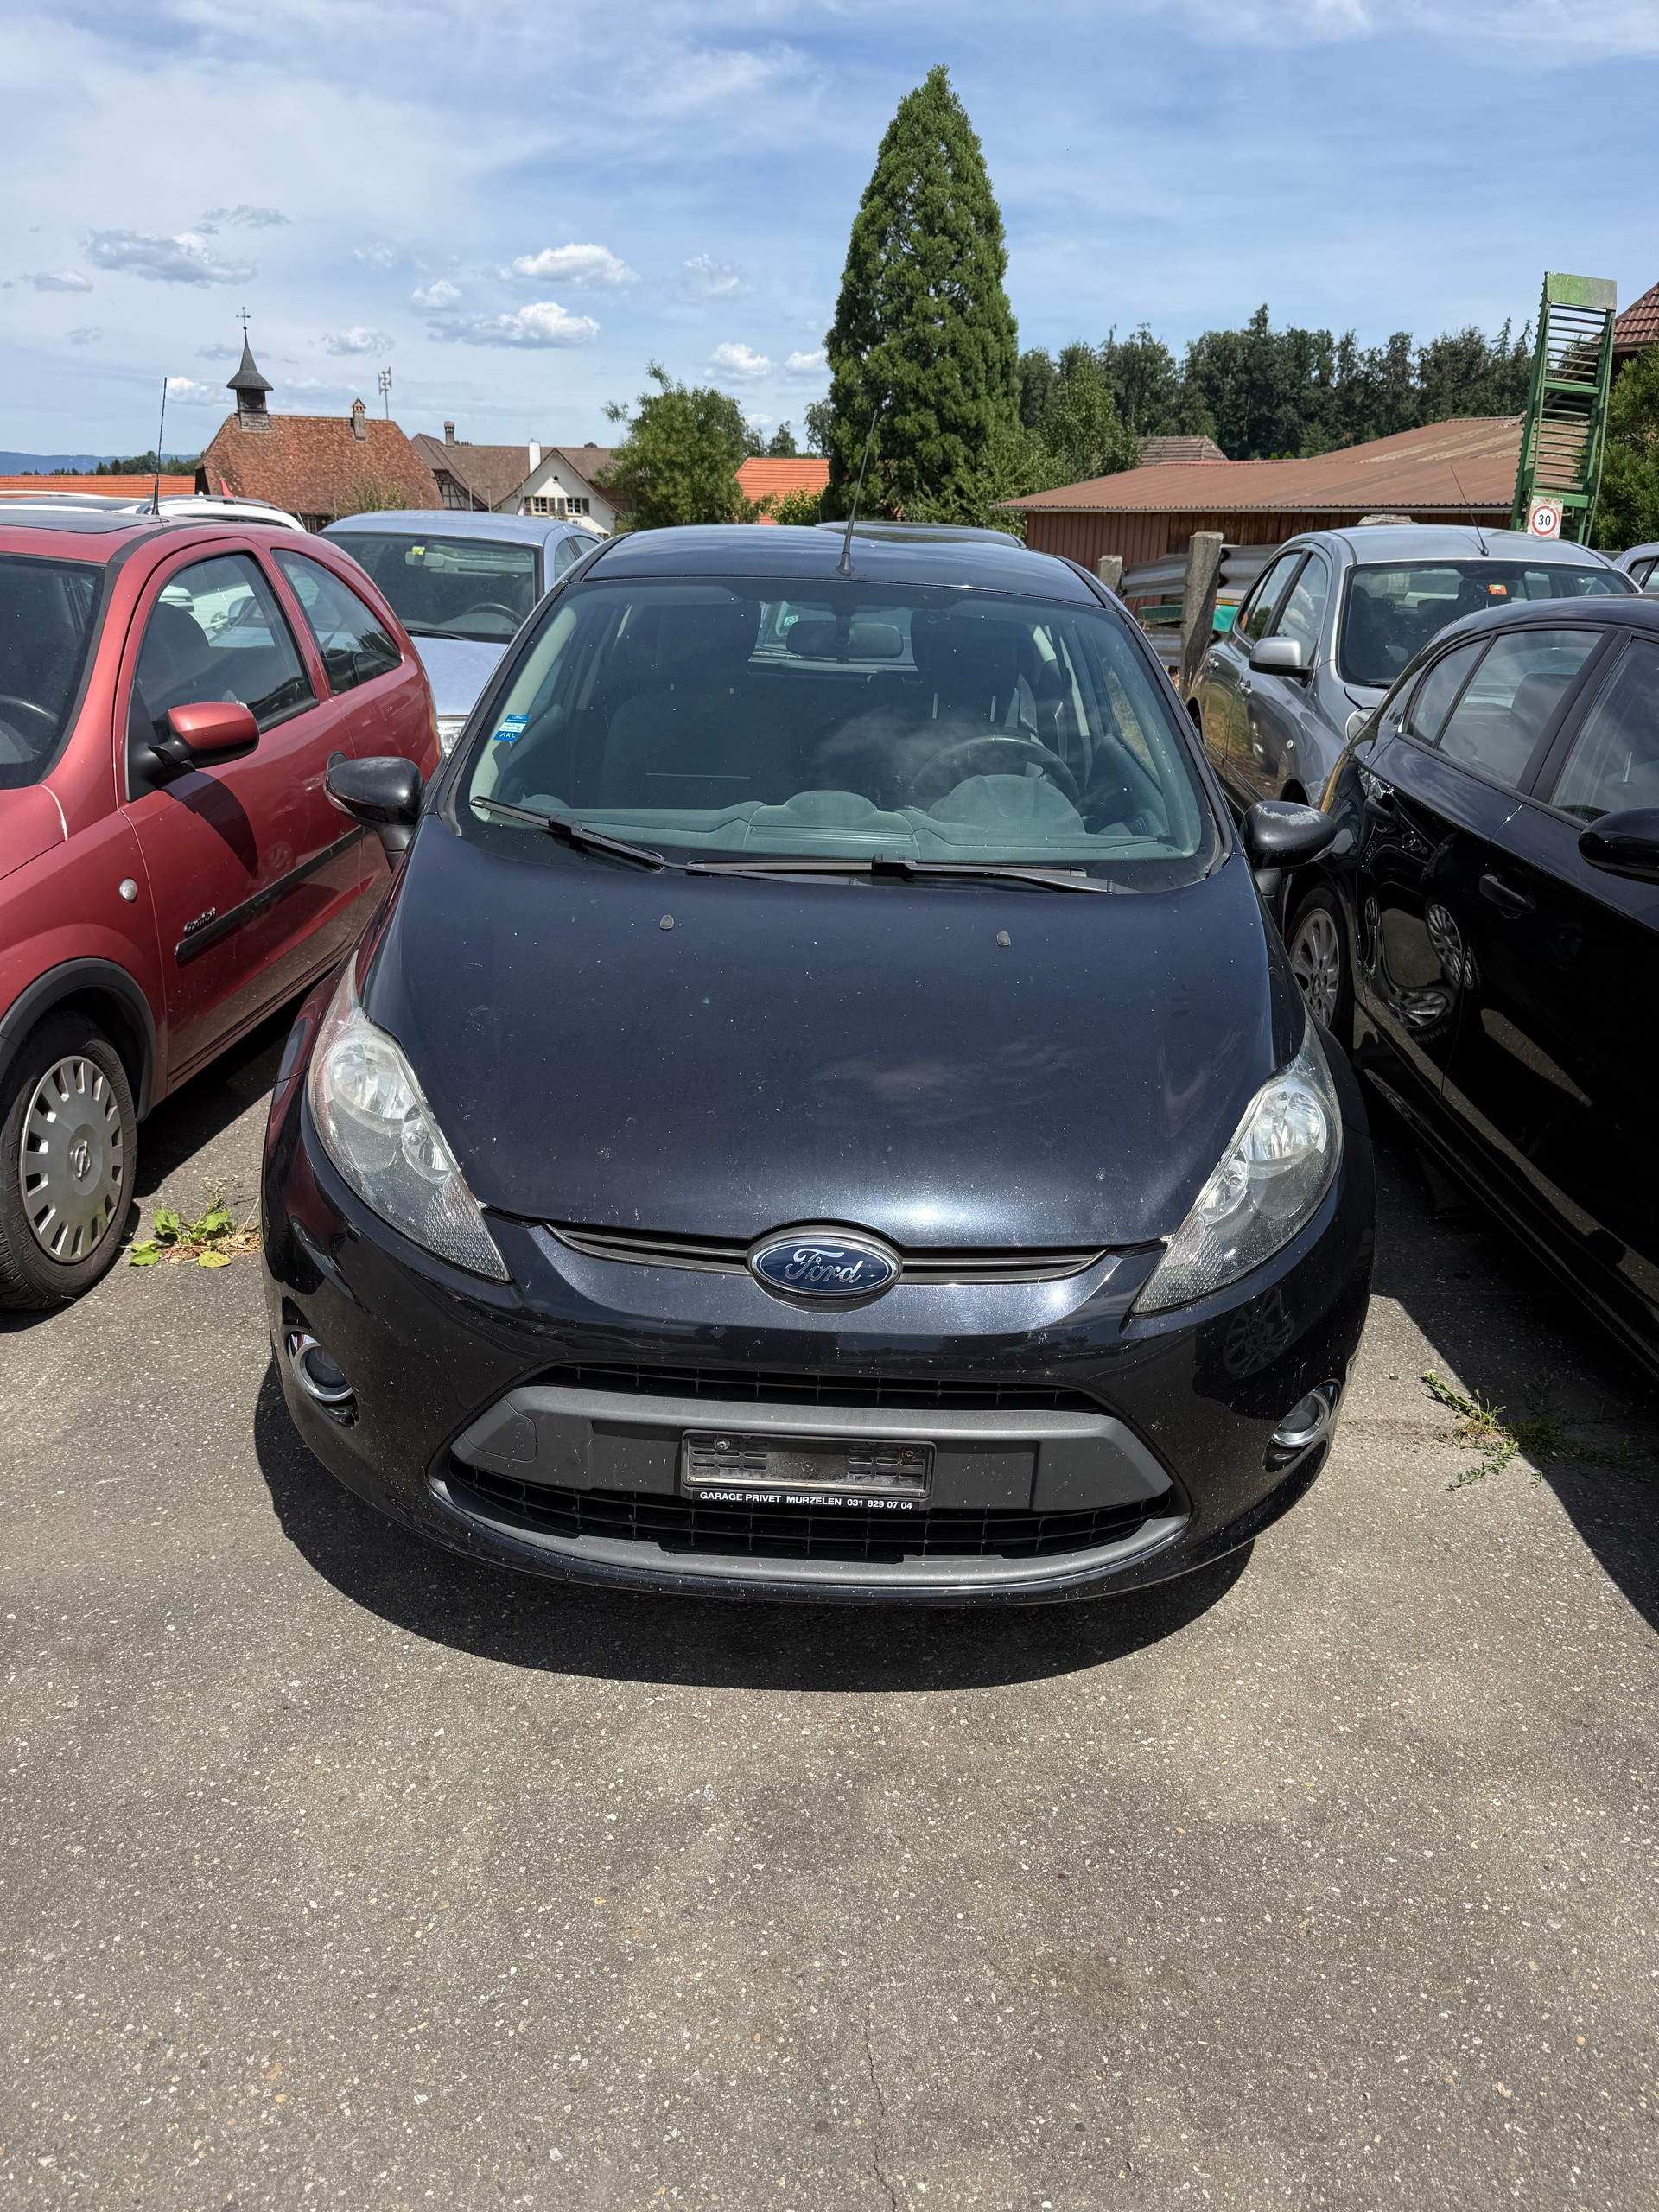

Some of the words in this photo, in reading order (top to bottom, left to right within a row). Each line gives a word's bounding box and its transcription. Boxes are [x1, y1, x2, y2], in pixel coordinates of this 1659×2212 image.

[1538, 514, 1551, 526] 30
[784, 1248, 864, 1283] Ford
[700, 1491, 743, 1501] GARAGE
[745, 1494, 781, 1503] PRIVET
[786, 1496, 842, 1505] MURZELEN
